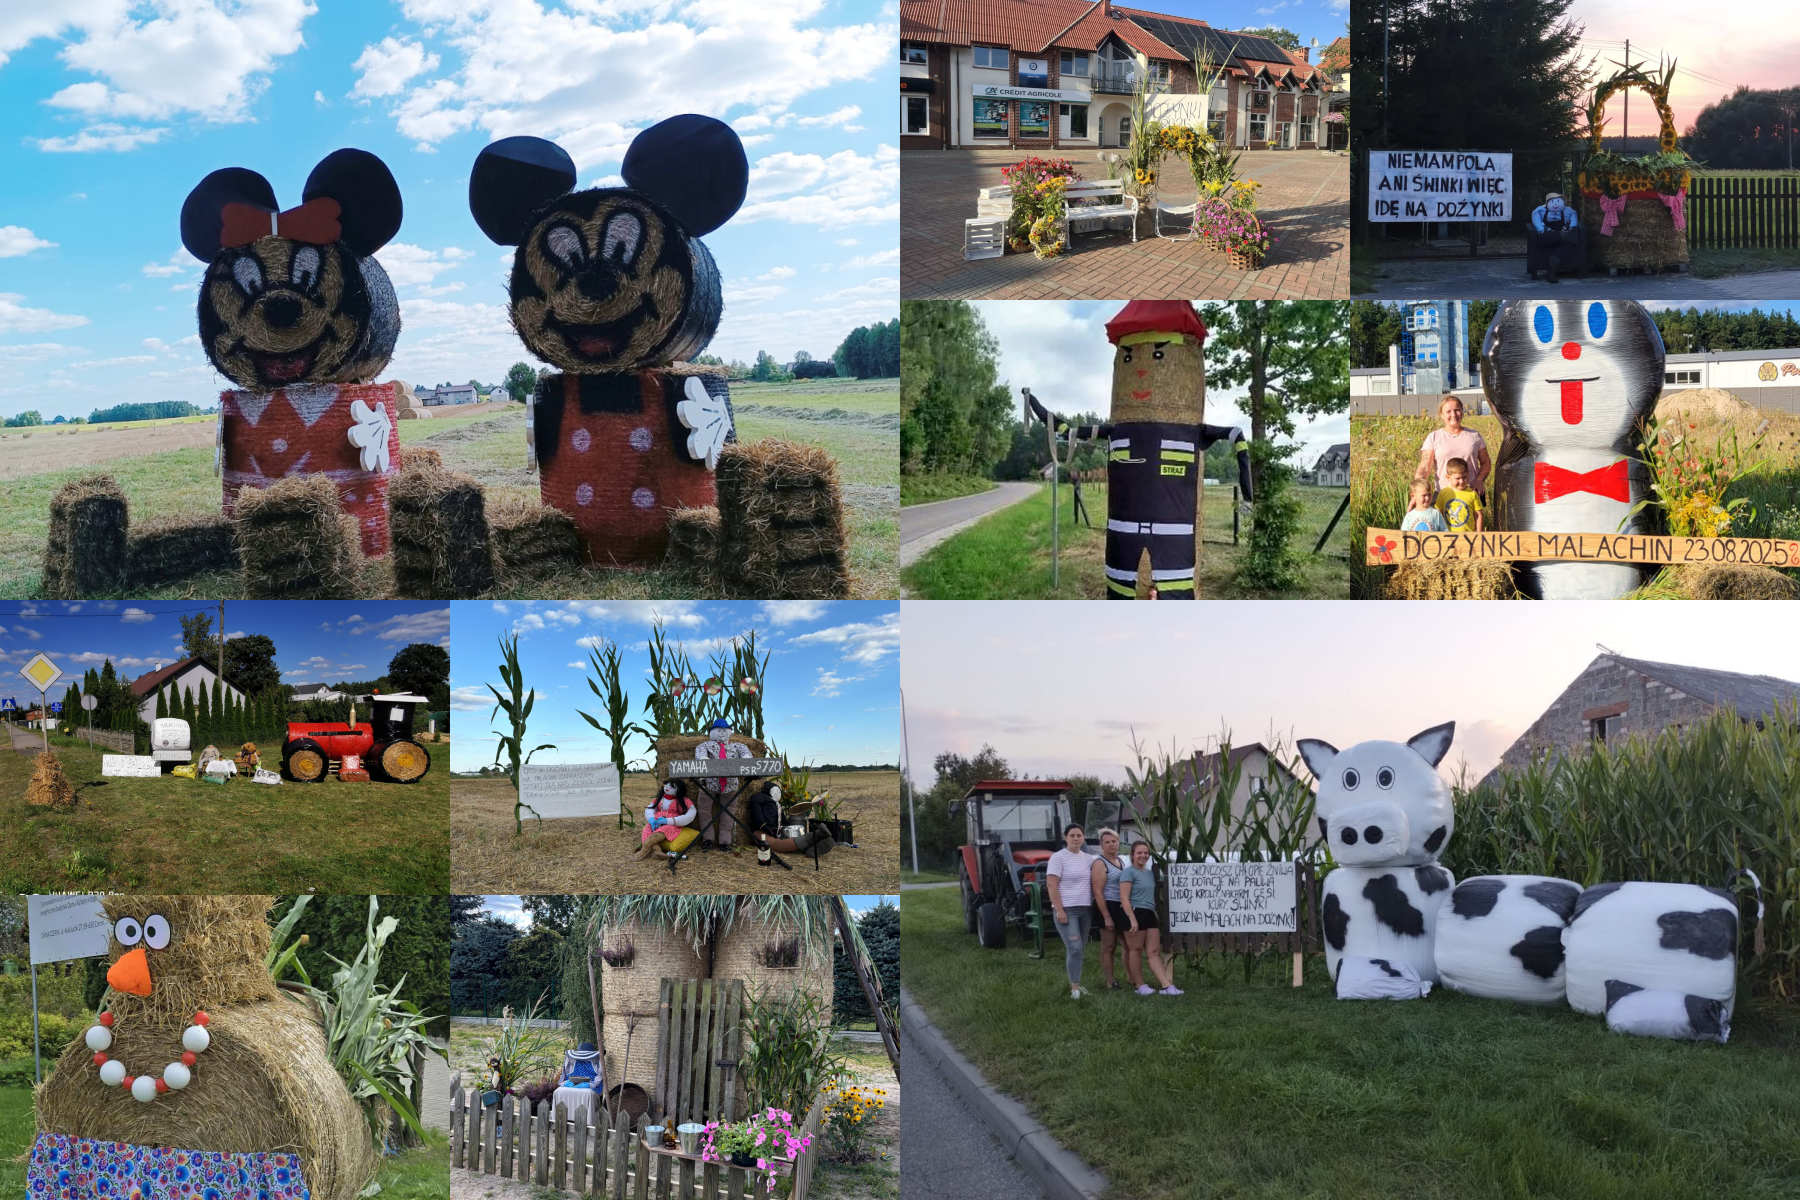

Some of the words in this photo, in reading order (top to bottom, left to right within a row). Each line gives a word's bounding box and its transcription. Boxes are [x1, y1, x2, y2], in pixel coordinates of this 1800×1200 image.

[1378, 175, 1408, 191] ANI
[1412, 174, 1463, 193] ŚWINKI
[1468, 178, 1504, 196] WIĘC
[1375, 200, 1400, 218] IDĘ
[1405, 201, 1428, 217] NA
[1538, 534, 1672, 562] MALACHIN
[1684, 538, 1789, 566] 23.08.2025
[670, 760, 708, 774] YAMAHA
[522, 790, 560, 799] PERKUSISTA
[1170, 864, 1189, 876] KIEDY
[1266, 862, 1294, 876] ŻNIWA
[1228, 876, 1240, 887] NA
[1244, 876, 1275, 888] PALIWA
[1170, 888, 1194, 904] WYDOJ
[1170, 910, 1190, 928] JEDŹ
[1192, 910, 1202, 923] NA
[1204, 911, 1240, 928] MALACH
[1243, 912, 1256, 925] NA
